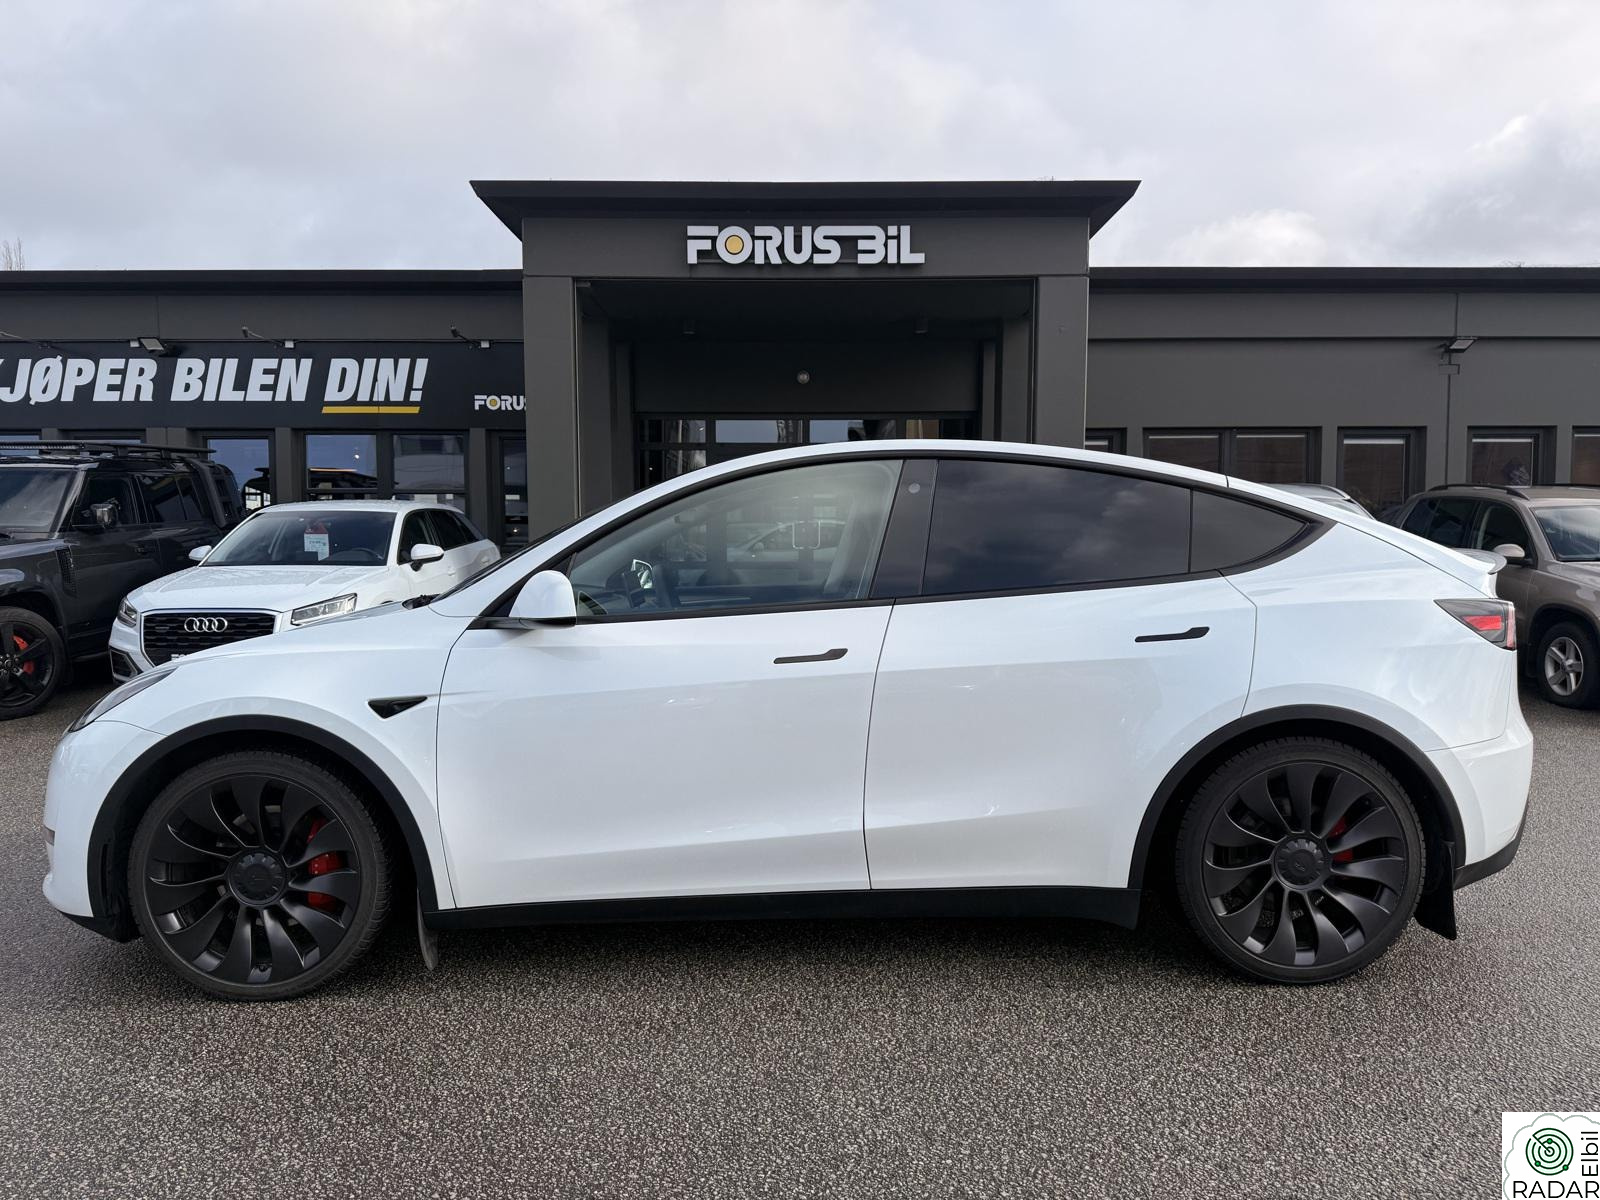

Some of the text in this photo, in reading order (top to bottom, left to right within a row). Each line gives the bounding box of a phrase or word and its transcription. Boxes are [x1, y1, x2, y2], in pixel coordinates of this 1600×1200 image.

[687, 225, 842, 264] FORUS
[0, 355, 429, 405] JØPER BILEN DIN!
[474, 395, 527, 410] FORU
